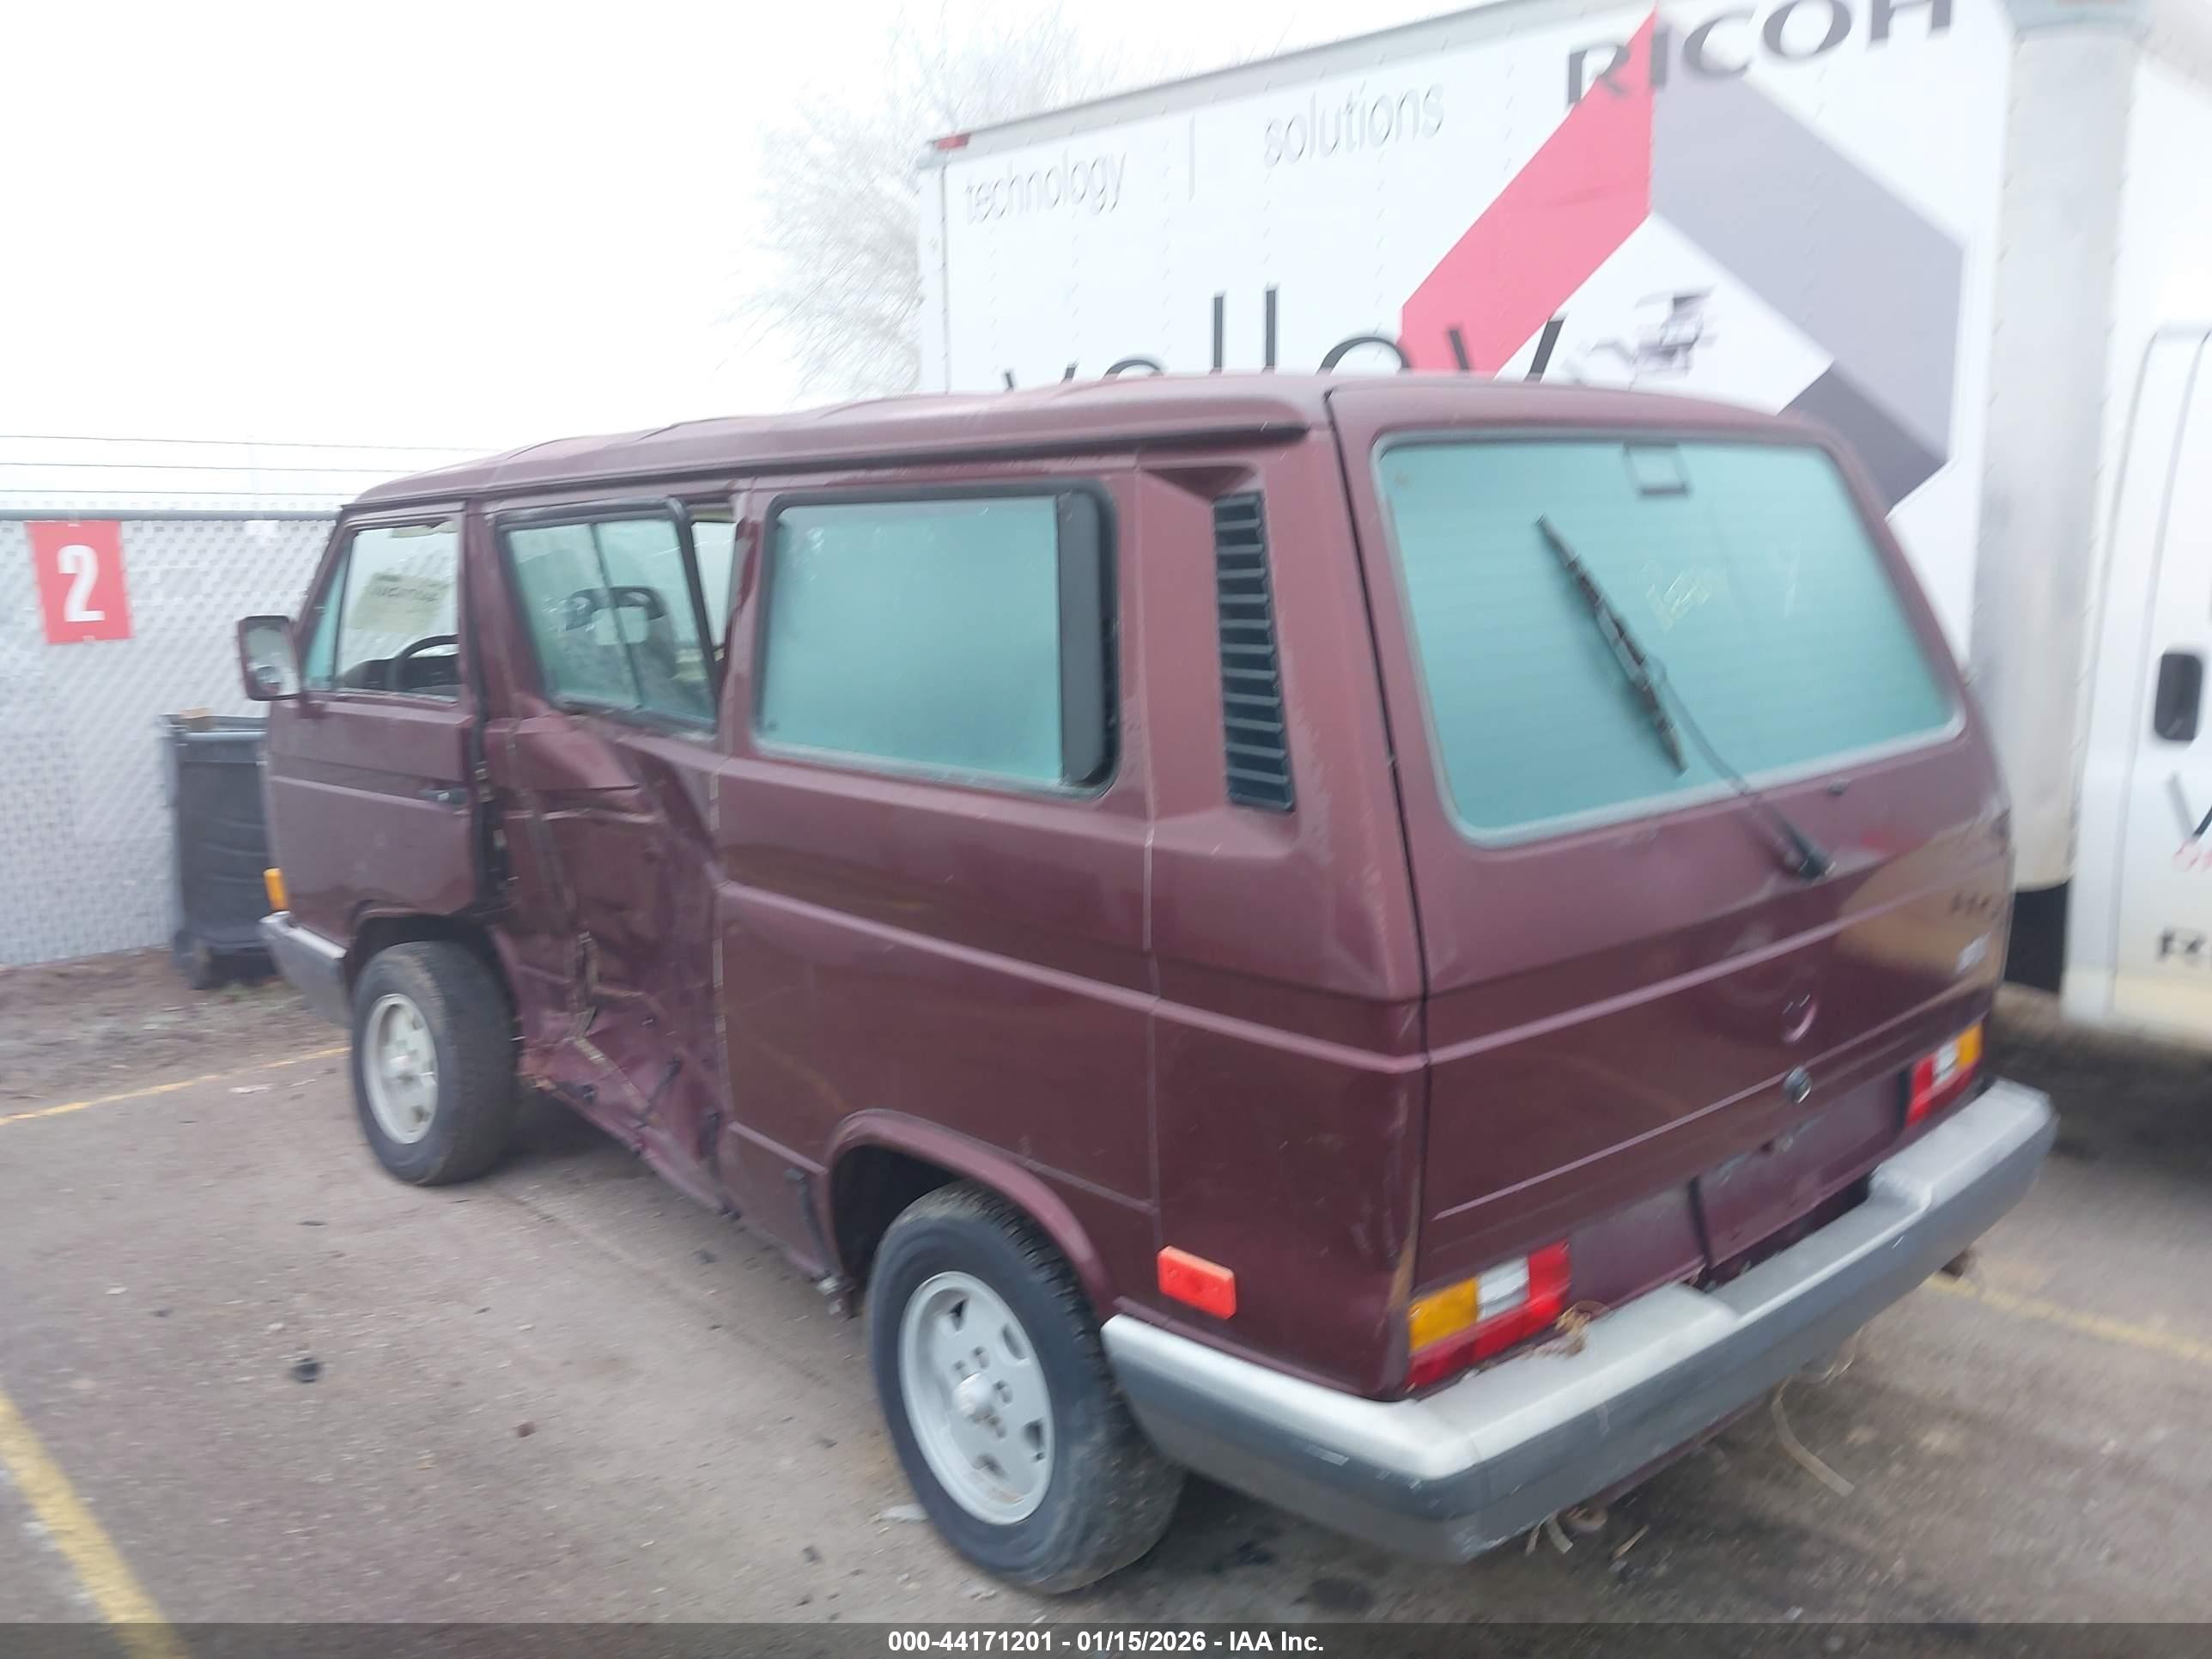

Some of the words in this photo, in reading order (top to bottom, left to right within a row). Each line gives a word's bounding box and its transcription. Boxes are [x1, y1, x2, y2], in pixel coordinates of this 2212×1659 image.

[1566, 0, 1954, 105] RICOH
[964, 148, 1127, 227] technology
[1263, 83, 1445, 167] solutions
[57, 544, 106, 623] 2
